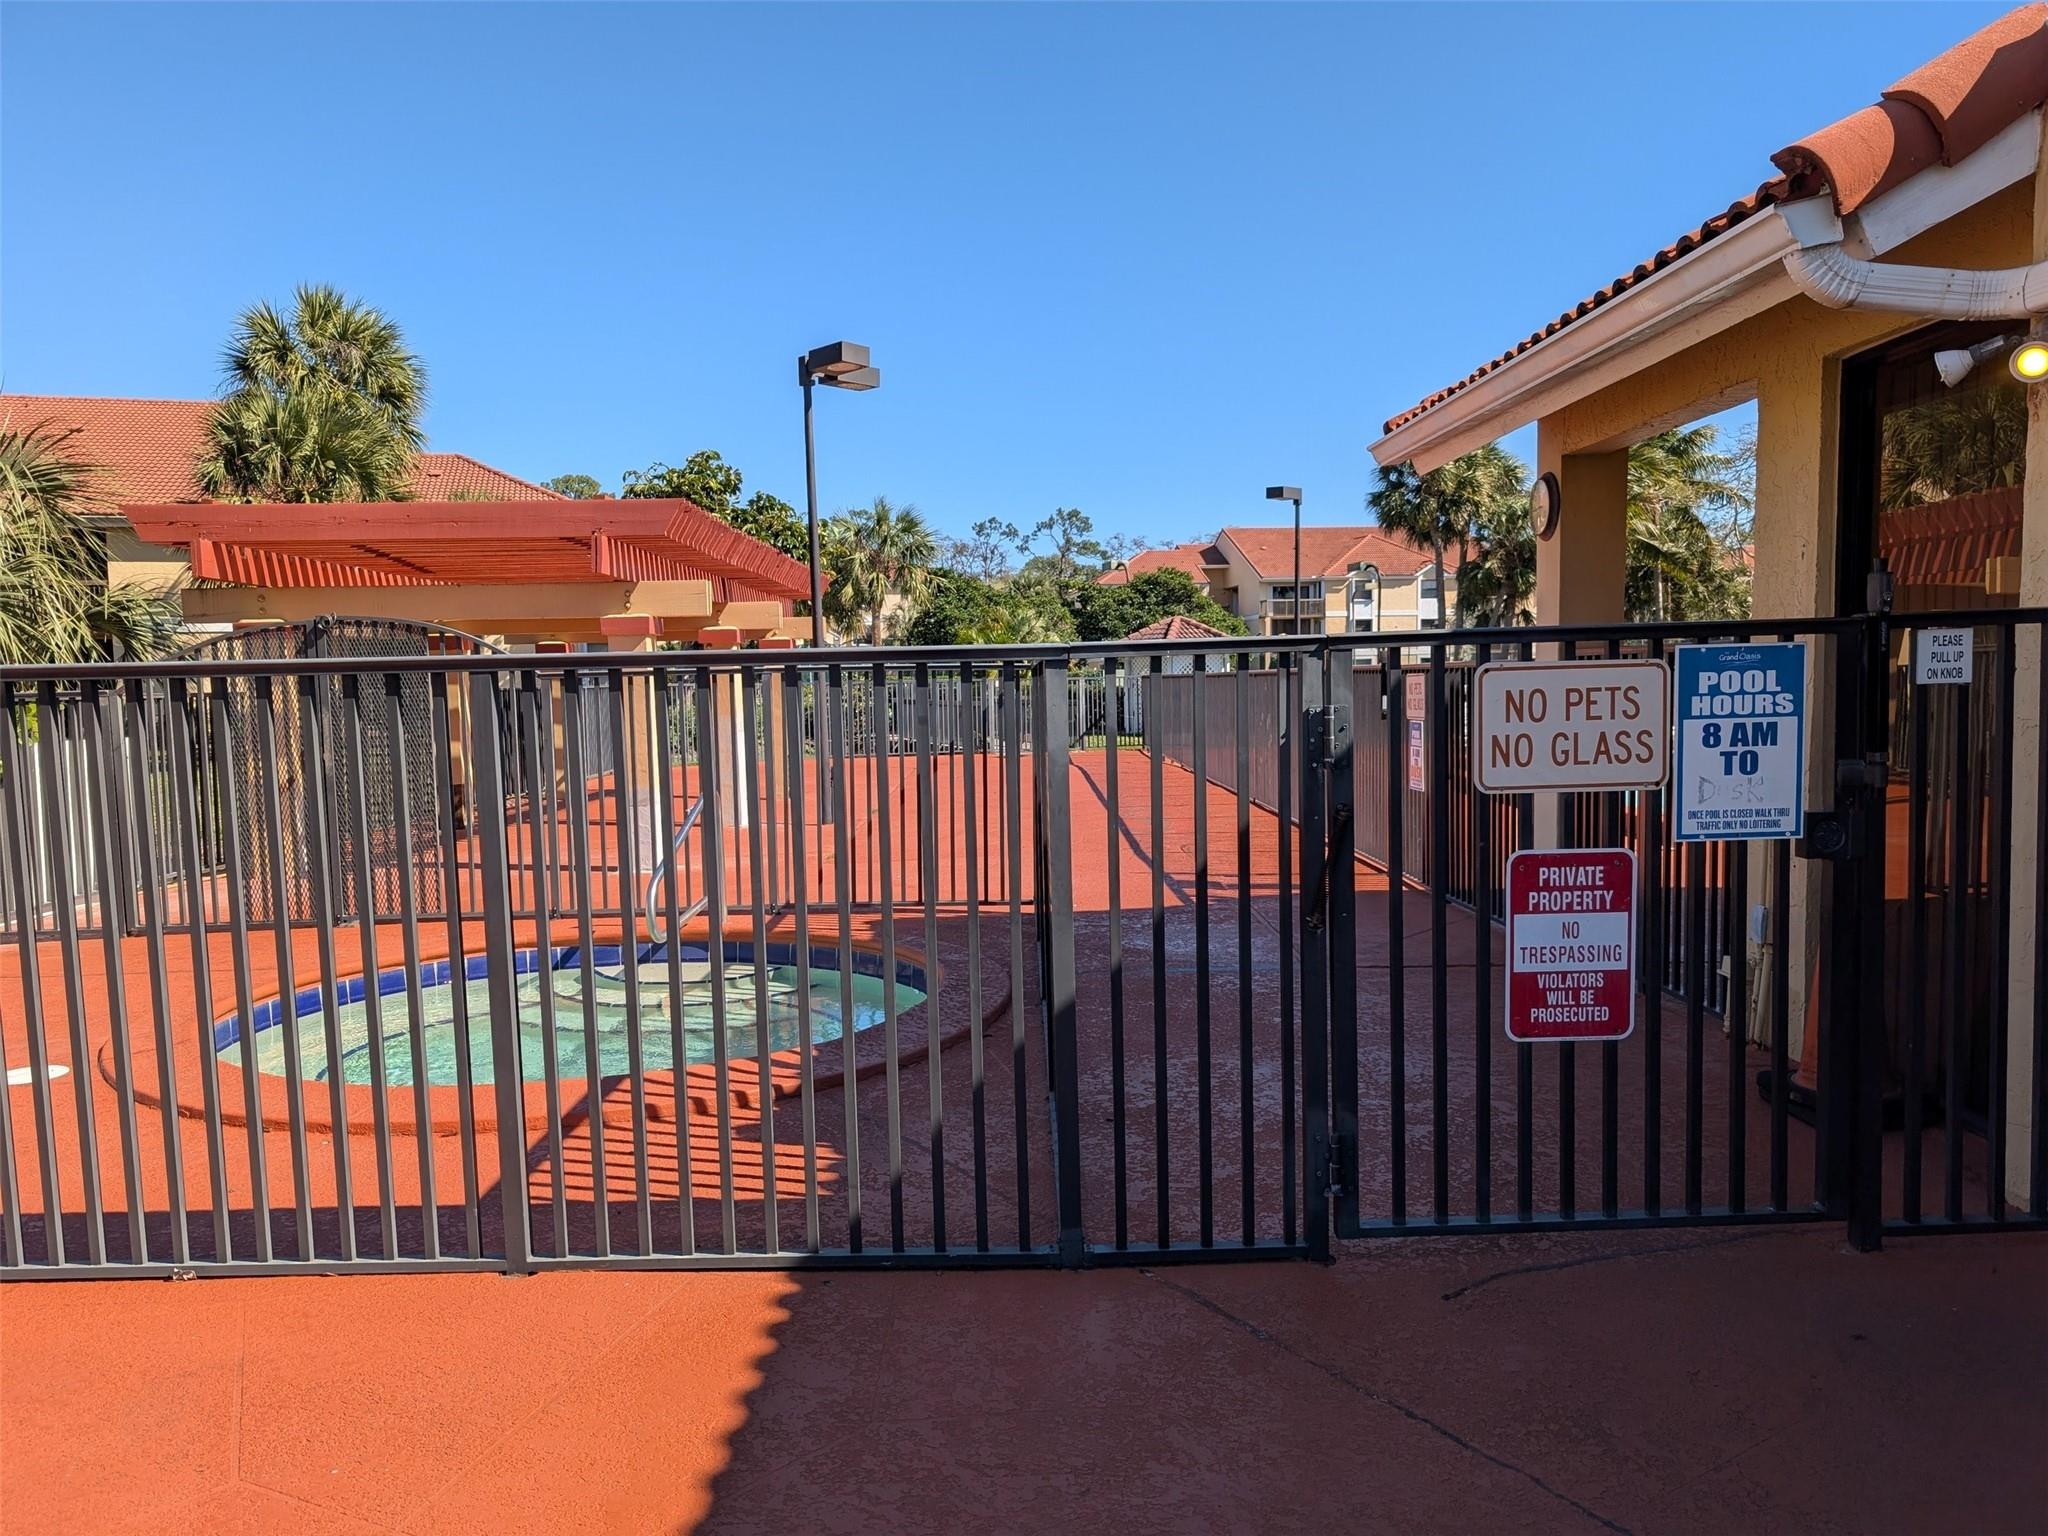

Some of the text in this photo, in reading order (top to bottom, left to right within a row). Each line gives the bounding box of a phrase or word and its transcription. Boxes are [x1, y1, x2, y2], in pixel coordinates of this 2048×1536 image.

[1933, 635, 1964, 646] PLEASE
[1719, 652, 1738, 661] Grand
[1931, 651, 1964, 663] PULL UP
[1927, 667, 1963, 679] ON KNOB
[1699, 670, 1781, 694] POOL
[1505, 686, 1640, 723] NO PETS
[1692, 693, 1794, 716] HOURS
[1702, 722, 1778, 748] 8 AM
[1492, 730, 1654, 768] NO GLASS
[1720, 750, 1759, 776] TO
[1688, 808, 1790, 820] ONCE POOL IS CLOSED WALK THRU
[1696, 819, 1781, 830] TRAFFIC ONLY NO LOITERING
[1539, 866, 1604, 887] PRIVATE
[1528, 890, 1613, 911] PROPERTY
[1562, 922, 1579, 939] NO
[1520, 944, 1622, 964] TRESPASSING
[1537, 972, 1604, 988] VIOLATORS
[1547, 990, 1594, 1005] WILL BE
[1530, 1007, 1609, 1023] PROSECUTED
